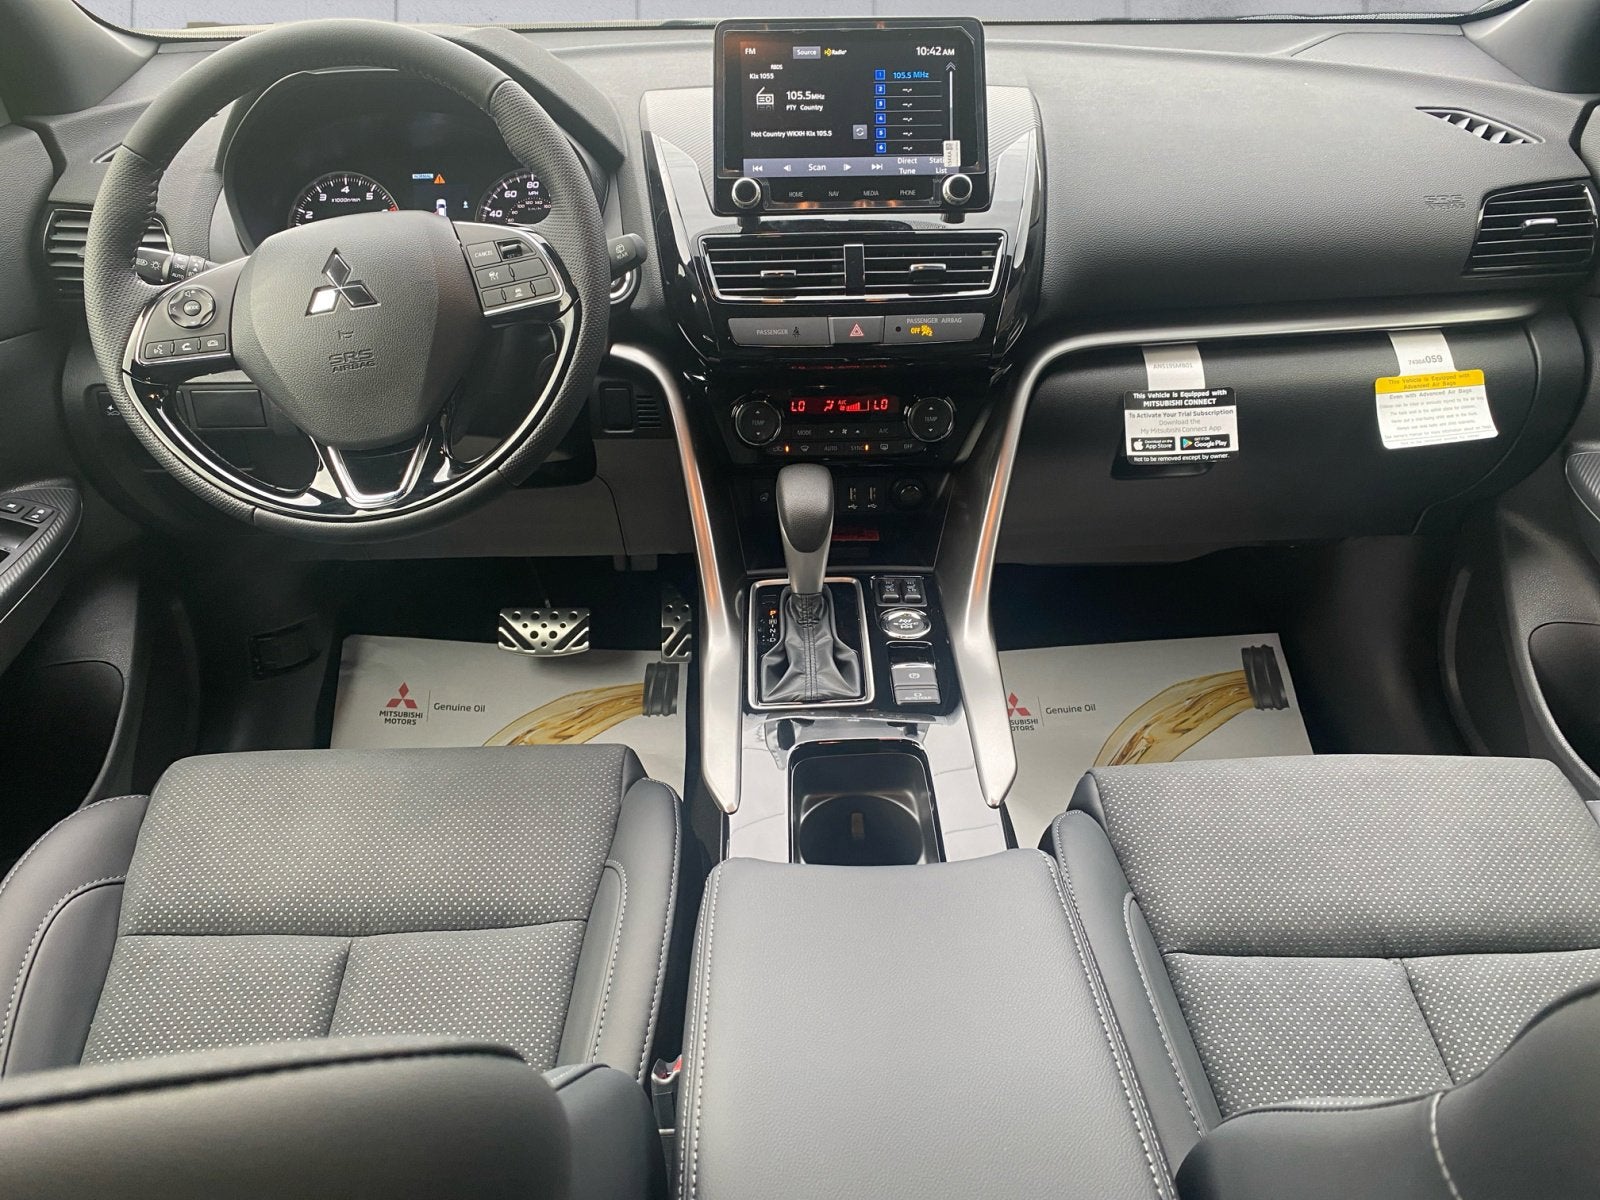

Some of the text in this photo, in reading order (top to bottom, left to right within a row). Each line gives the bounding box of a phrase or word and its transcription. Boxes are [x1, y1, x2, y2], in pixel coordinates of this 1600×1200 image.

[745, 47, 756, 55] FM
[915, 46, 955, 56] 10:42 AM
[799, 104, 823, 112] Country
[762, 130, 785, 139] Country
[808, 163, 827, 171] Scan
[898, 167, 916, 175] Tune
[526, 181, 539, 189] 80
[341, 186, 350, 194] 4
[504, 190, 518, 198] 60
[319, 193, 327, 201] 3
[365, 192, 374, 200] 5
[305, 210, 313, 219] 2
[489, 210, 503, 218] 40
[329, 348, 373, 364] SRS
[1180, 390, 1209, 398] Equipped
[1143, 398, 1217, 407] MITSUBISHI CONNECT
[1193, 409, 1234, 418] Subscription
[433, 702, 486, 713] Genuine Oil
[1045, 704, 1096, 715] Genuine Oil
[379, 710, 423, 719] MITSUBISHI
[384, 718, 417, 726] MOTORS
[1009, 718, 1039, 726] SUBISHI
